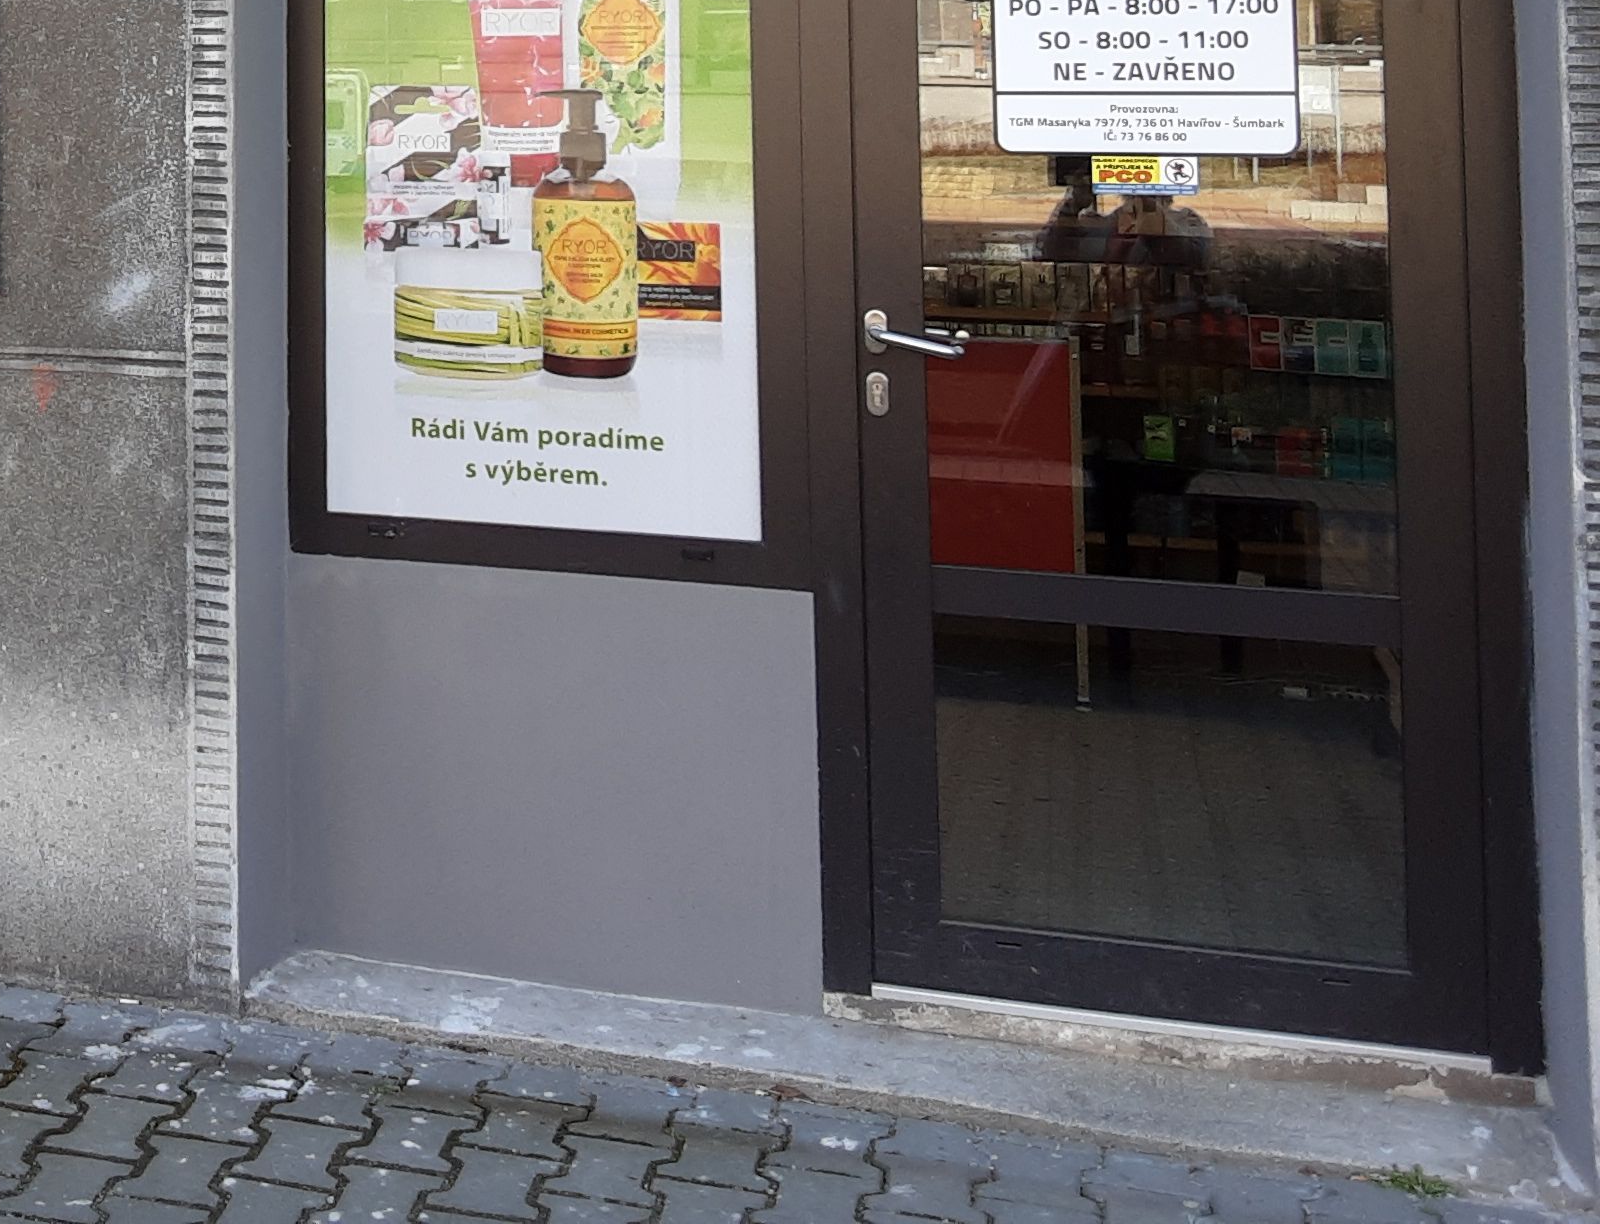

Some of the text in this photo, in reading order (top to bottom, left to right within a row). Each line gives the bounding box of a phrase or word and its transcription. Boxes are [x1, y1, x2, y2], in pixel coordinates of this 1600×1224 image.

[1038, 31, 1070, 50] SO
[1096, 31, 1151, 49] 8:00
[1178, 30, 1249, 49] 11:00
[1053, 63, 1087, 81] NE
[1113, 56, 1235, 81] ZAVŘENO
[1110, 104, 1178, 115] Provozovna:
[1009, 118, 1034, 127] TGM
[1037, 117, 1091, 129] Masaryka
[1094, 118, 1132, 129] 797/9,
[1136, 118, 1157, 127] 736
[1159, 118, 1174, 127] 01
[1233, 116, 1285, 128] Šumbark
[398, 134, 448, 150] RYOR
[1120, 131, 1134, 141] 73
[1138, 131, 1152, 141] 76
[1155, 131, 1169, 141] 86
[1172, 131, 1187, 141] 00
[1099, 170, 1152, 183] PCO
[562, 239, 607, 254] RYOR
[411, 417, 665, 452] Rádi Vám poradíme
[465, 459, 608, 486] s výběrem.
